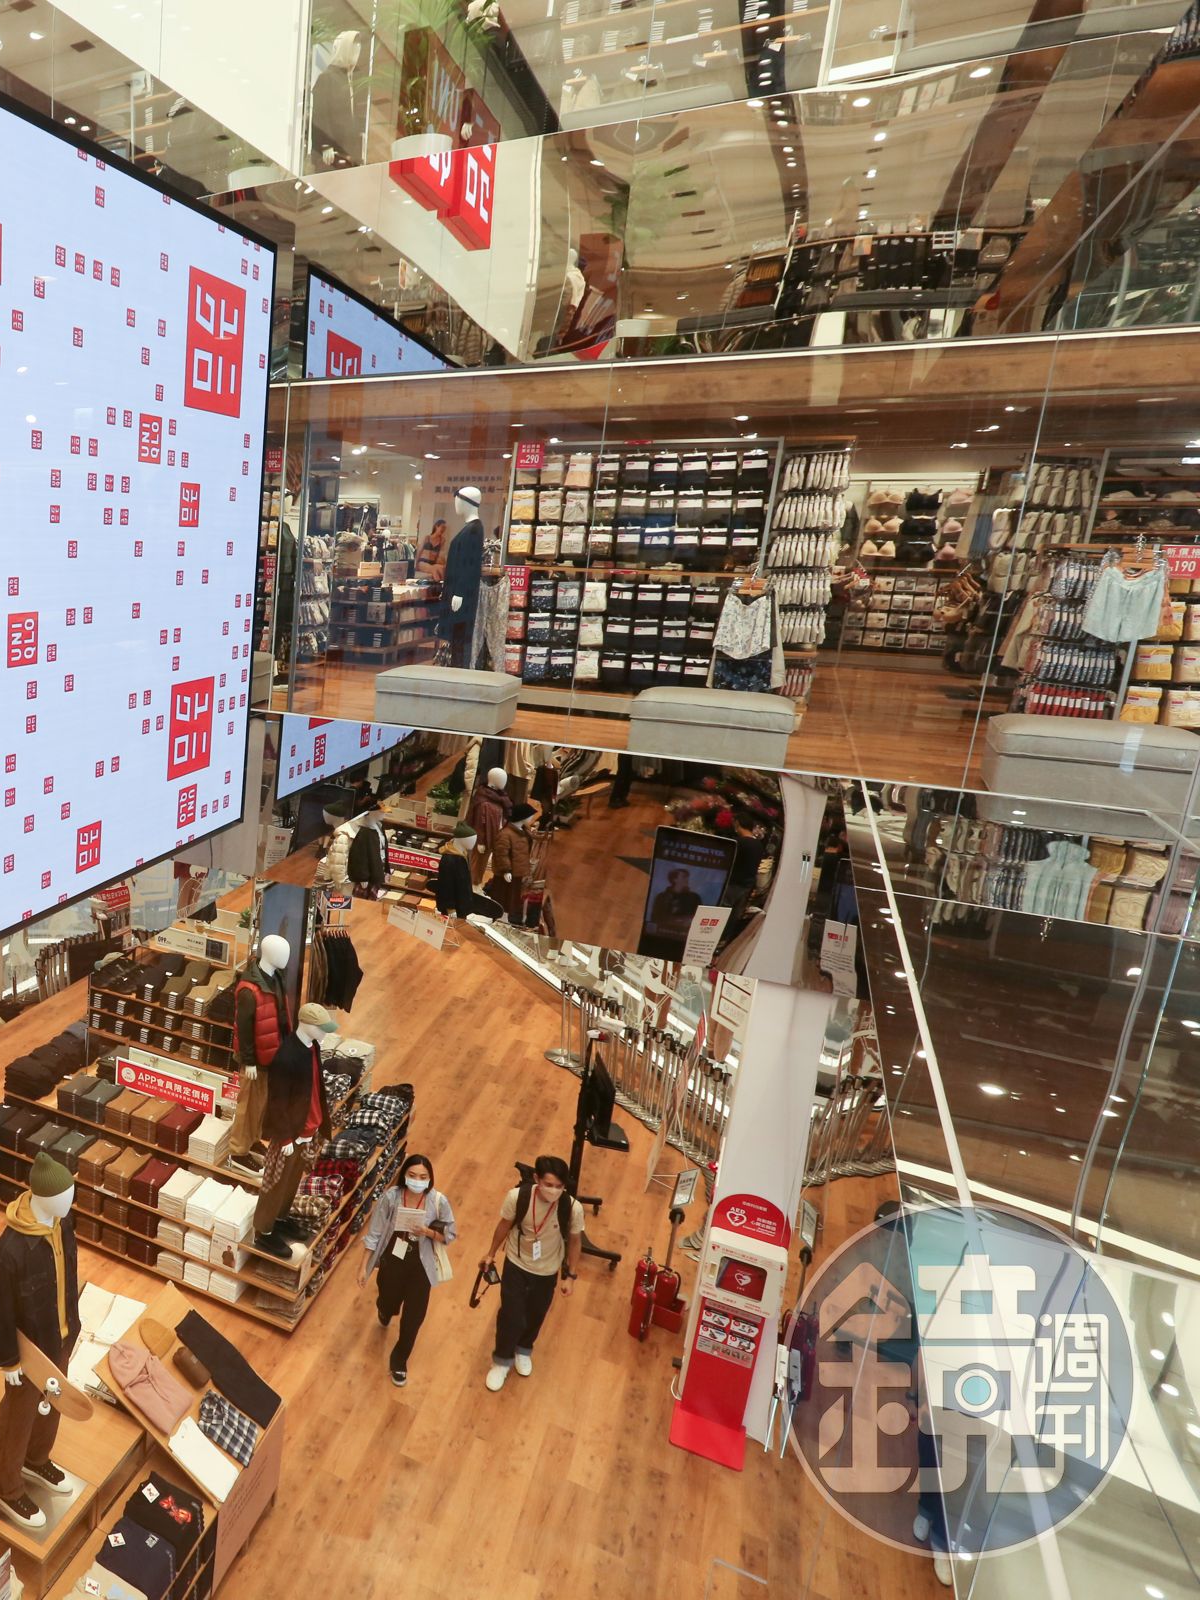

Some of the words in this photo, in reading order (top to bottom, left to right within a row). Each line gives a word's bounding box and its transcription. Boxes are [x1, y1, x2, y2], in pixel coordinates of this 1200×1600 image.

[141, 423, 150, 457] UNI
[150, 422, 160, 458] QLO
[11, 623, 22, 661] UNI
[24, 618, 36, 659] QLO
[179, 792, 188, 823] QLO
[187, 789, 195, 817] UNI
[137, 1072, 210, 1103] APP會員限定價格
